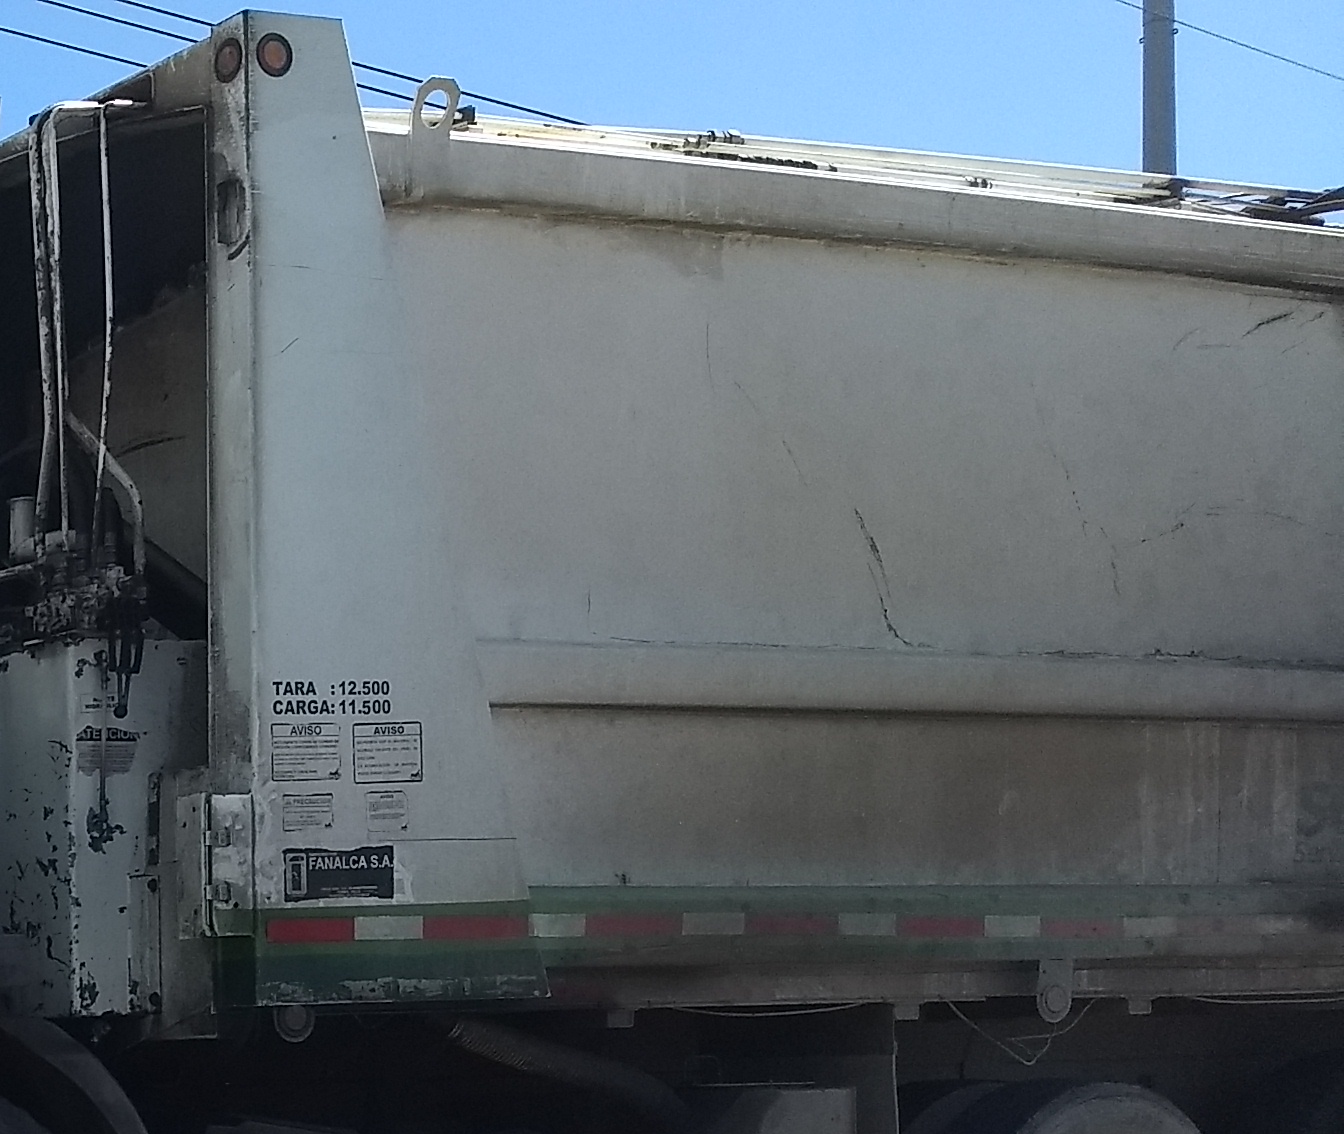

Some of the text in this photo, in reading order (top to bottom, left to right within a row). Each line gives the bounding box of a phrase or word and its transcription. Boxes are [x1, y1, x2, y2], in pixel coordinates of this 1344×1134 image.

[273, 681, 317, 696] TARA
[339, 681, 390, 696] 12.500
[339, 700, 391, 715] 11.500
[290, 725, 322, 736] AVISO
[373, 725, 405, 736] AVISO
[309, 854, 394, 870] FANALCA S.A.
